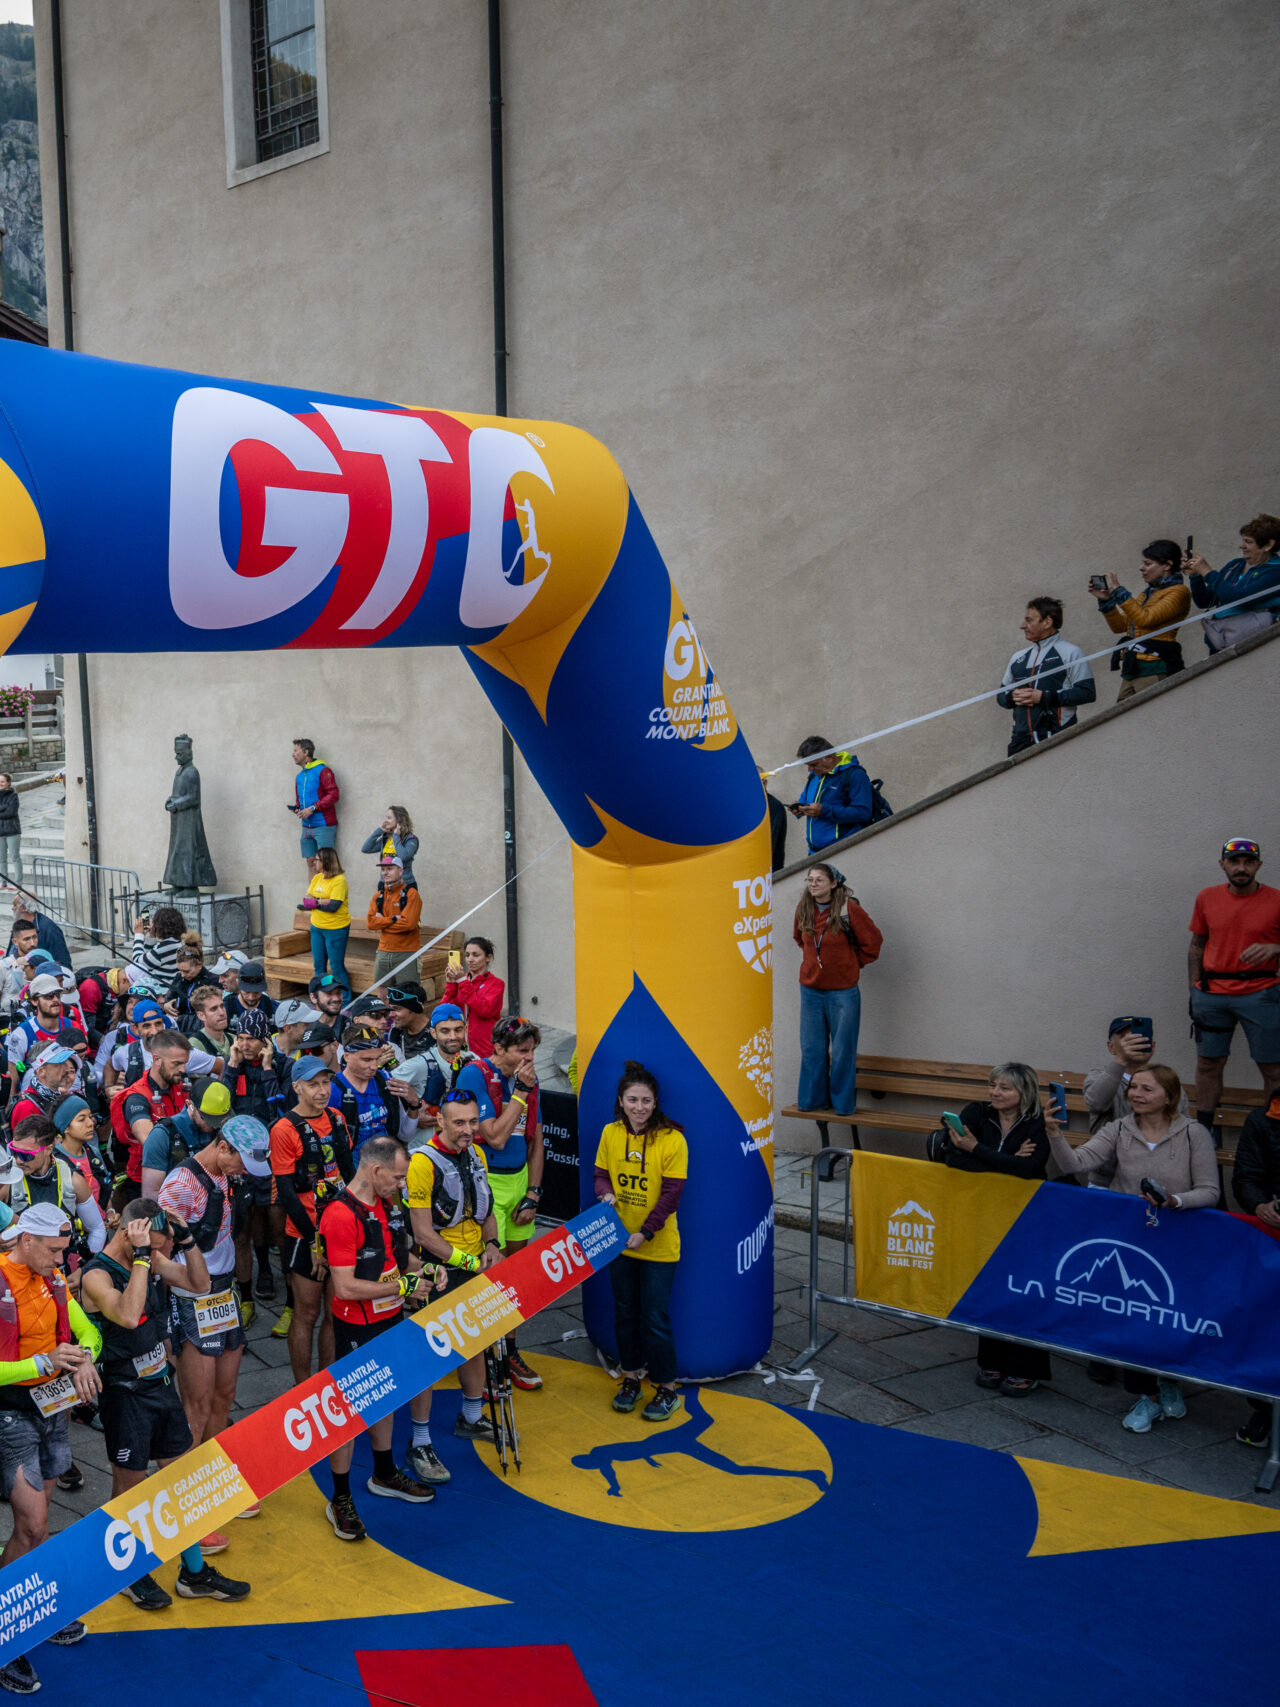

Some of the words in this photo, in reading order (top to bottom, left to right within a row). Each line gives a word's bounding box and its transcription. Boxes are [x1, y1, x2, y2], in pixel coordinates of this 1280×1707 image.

[169, 387, 556, 630] GTC
[645, 718, 730, 740] MONT-BLANC
[648, 703, 727, 723] COURMAYEUR
[617, 1173, 648, 1191] GTC
[582, 1222, 617, 1249] COURMAYEUR
[585, 1232, 619, 1259] MONT-BLANC
[888, 1221, 935, 1239] MONT
[540, 1234, 586, 1282] GTC
[577, 1216, 608, 1239] GRANTRAIL
[887, 1237, 935, 1256] BLANC
[886, 1256, 910, 1269] TRAIL
[912, 1258, 934, 1271] FEST
[206, 1304, 230, 1322] 1609
[425, 1303, 481, 1357] GTC
[469, 1280, 505, 1308] GRANTRAIL
[475, 1287, 518, 1319] COURMAYEUR
[481, 1297, 522, 1330] MONT-BLANC
[1007, 1275, 1045, 1299] LA
[1055, 1286, 1224, 1338] SPORTIVA
[40, 1380, 66, 1400] 1363
[342, 1366, 394, 1405] COURMAYEUR
[348, 1378, 397, 1417] MONT-BLANC
[283, 1385, 348, 1452] GTC
[336, 1358, 380, 1393] GRANTRAIL
[178, 1462, 240, 1512] COURMAYEUR
[183, 1479, 244, 1527] MONT-BLANC
[105, 1489, 179, 1572] GTC
[174, 1455, 226, 1497] GRANTRAIL
